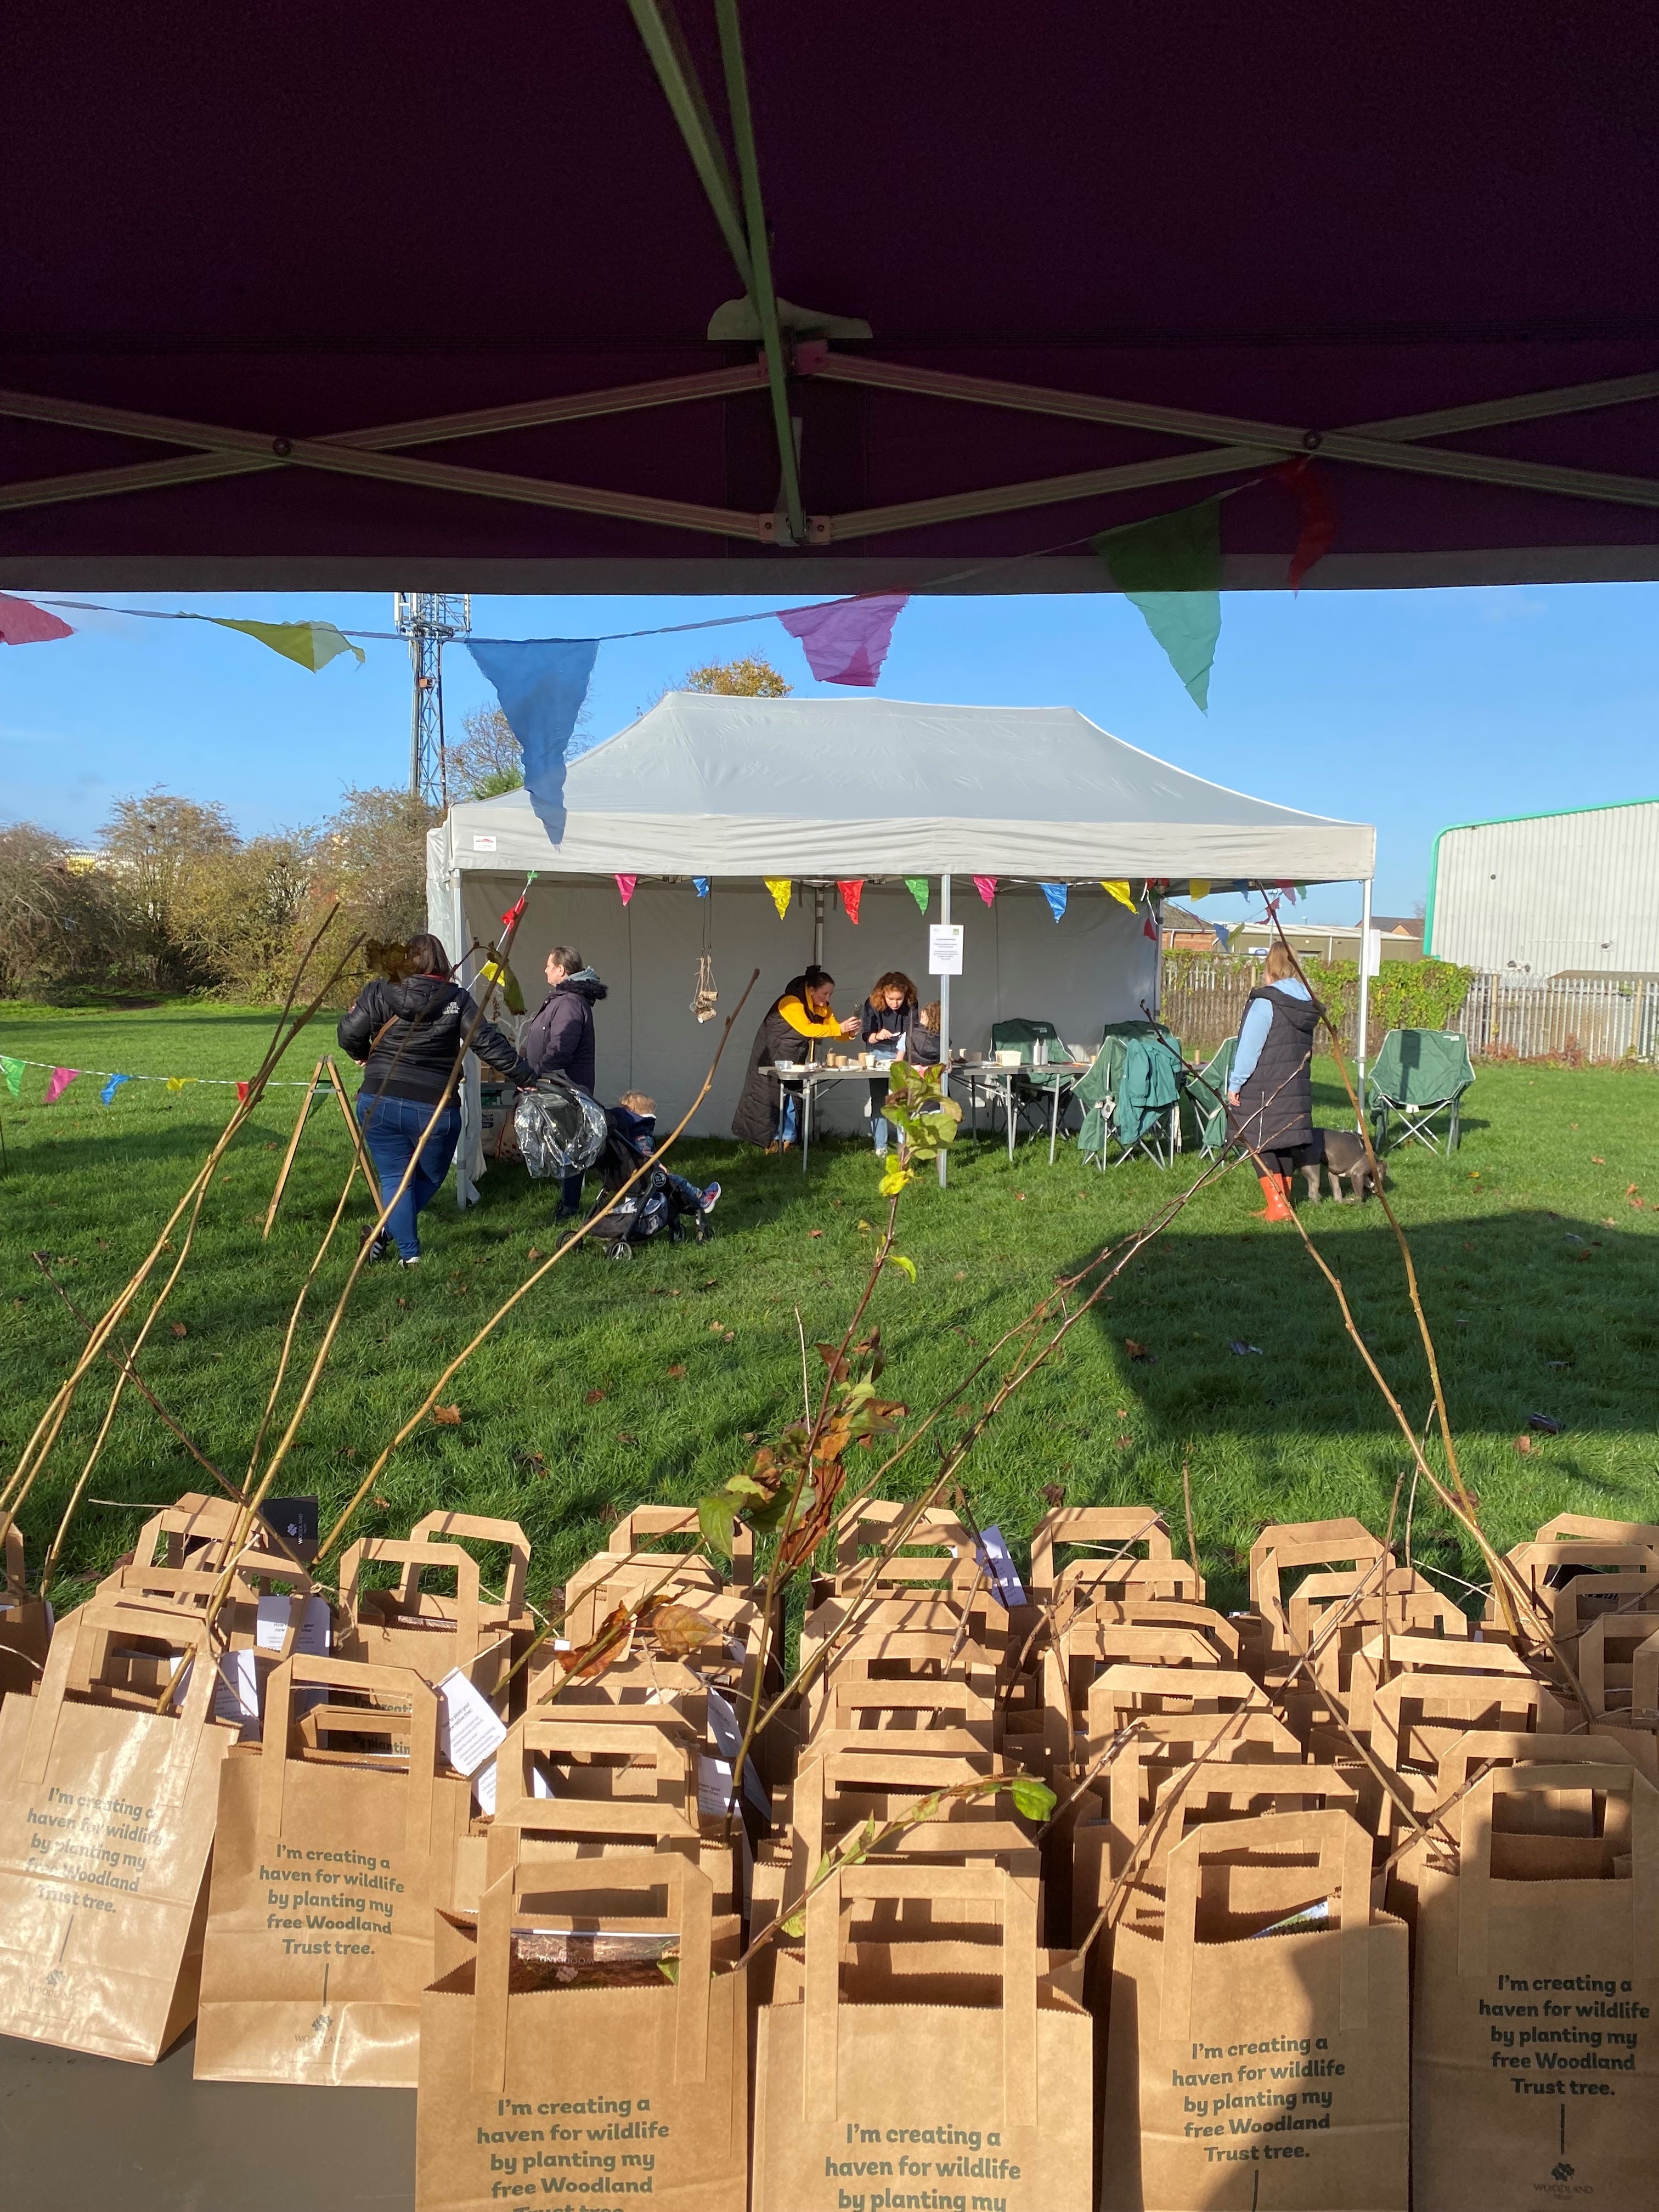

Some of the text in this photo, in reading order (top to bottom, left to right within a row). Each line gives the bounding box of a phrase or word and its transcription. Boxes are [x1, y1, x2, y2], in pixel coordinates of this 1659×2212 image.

[367, 1737, 410, 1754] plantin
[48, 1787, 74, 1805] I'm
[27, 1808, 76, 1830] haven
[31, 1833, 51, 1854] by
[123, 1853, 146, 1872] my
[277, 1844, 390, 1871] I'm creating a
[259, 1865, 404, 1893] haven for wildlife
[82, 1893, 116, 1914] tree.
[268, 1889, 393, 1917] by planting my
[267, 1914, 392, 1935] free Woodland
[282, 1939, 375, 1955] Trust tree.
[1498, 1974, 1632, 1997] I'm creating a
[1479, 2000, 1650, 2019] haven for wildlife
[295, 2034, 346, 2044] WOOLAND
[1192, 2035, 1328, 2059] I'm creating a
[1491, 2025, 1638, 2050] by planting my
[1491, 2052, 1635, 2070] free Woodland
[1172, 2059, 1346, 2087] haven for wildlife
[1510, 2078, 1615, 2096] Trust tree.
[498, 2096, 650, 2118] I'm creating a
[1184, 2089, 1333, 2117] by planting my
[477, 2121, 670, 2144] haven for wildlife
[847, 2123, 1001, 2151] I'm creating a
[1184, 2113, 1330, 2138] free Woodland
[490, 2151, 655, 2175] by planting my
[1203, 2145, 1310, 2163] Trust tree.
[825, 2155, 1022, 2180] haven for wildlife
[491, 2176, 653, 2199] free Woodland
[838, 2187, 1006, 2212] by planting my
